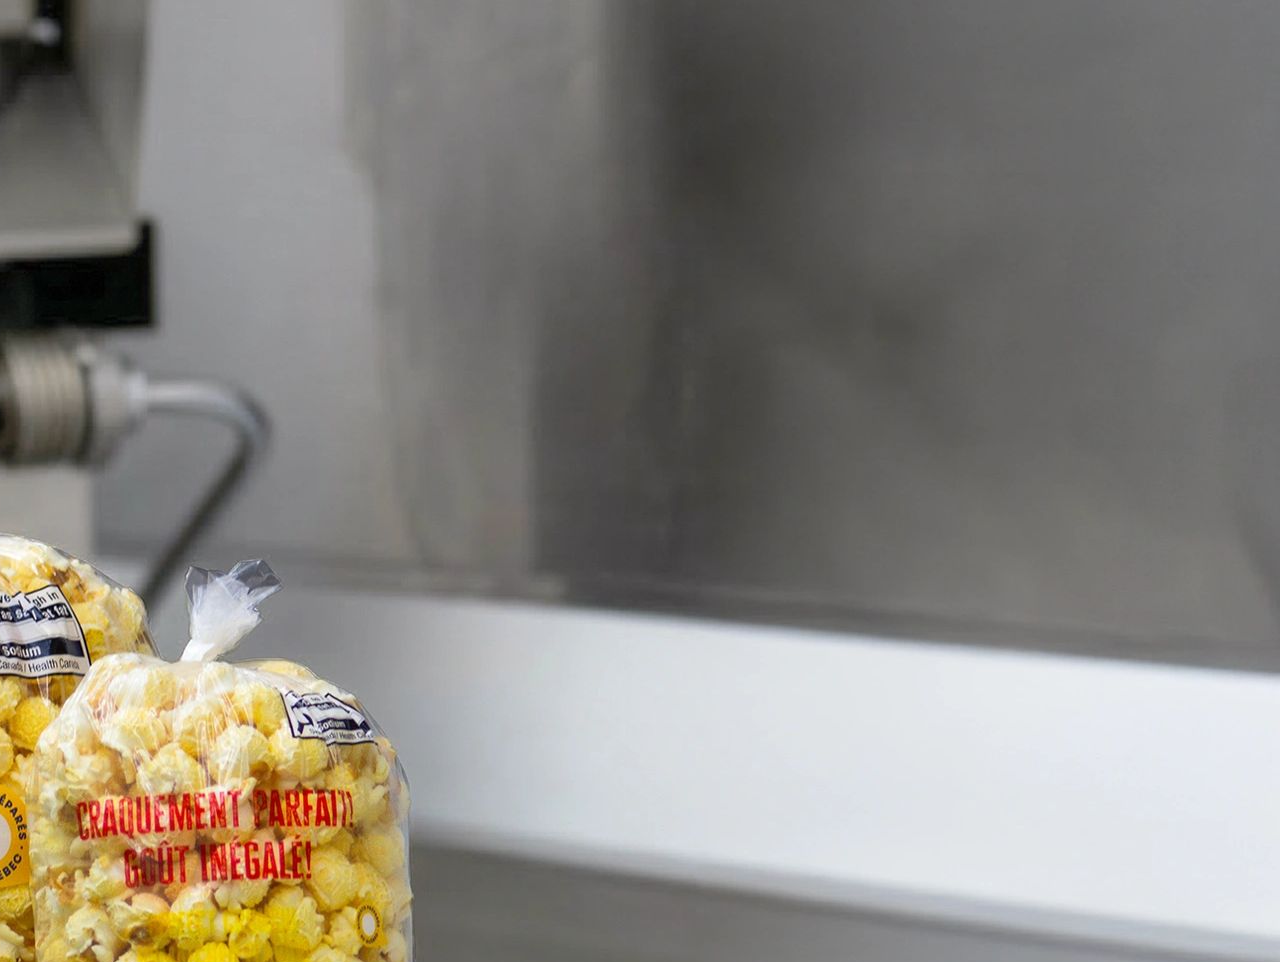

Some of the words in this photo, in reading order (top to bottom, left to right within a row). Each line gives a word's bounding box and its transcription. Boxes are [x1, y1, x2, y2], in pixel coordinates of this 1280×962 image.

[28, 660, 58, 673] Health
[75, 790, 244, 841] CRAQUEMENT
[124, 841, 190, 889] GOÛT
[200, 835, 313, 883] INÉGALÉ!
